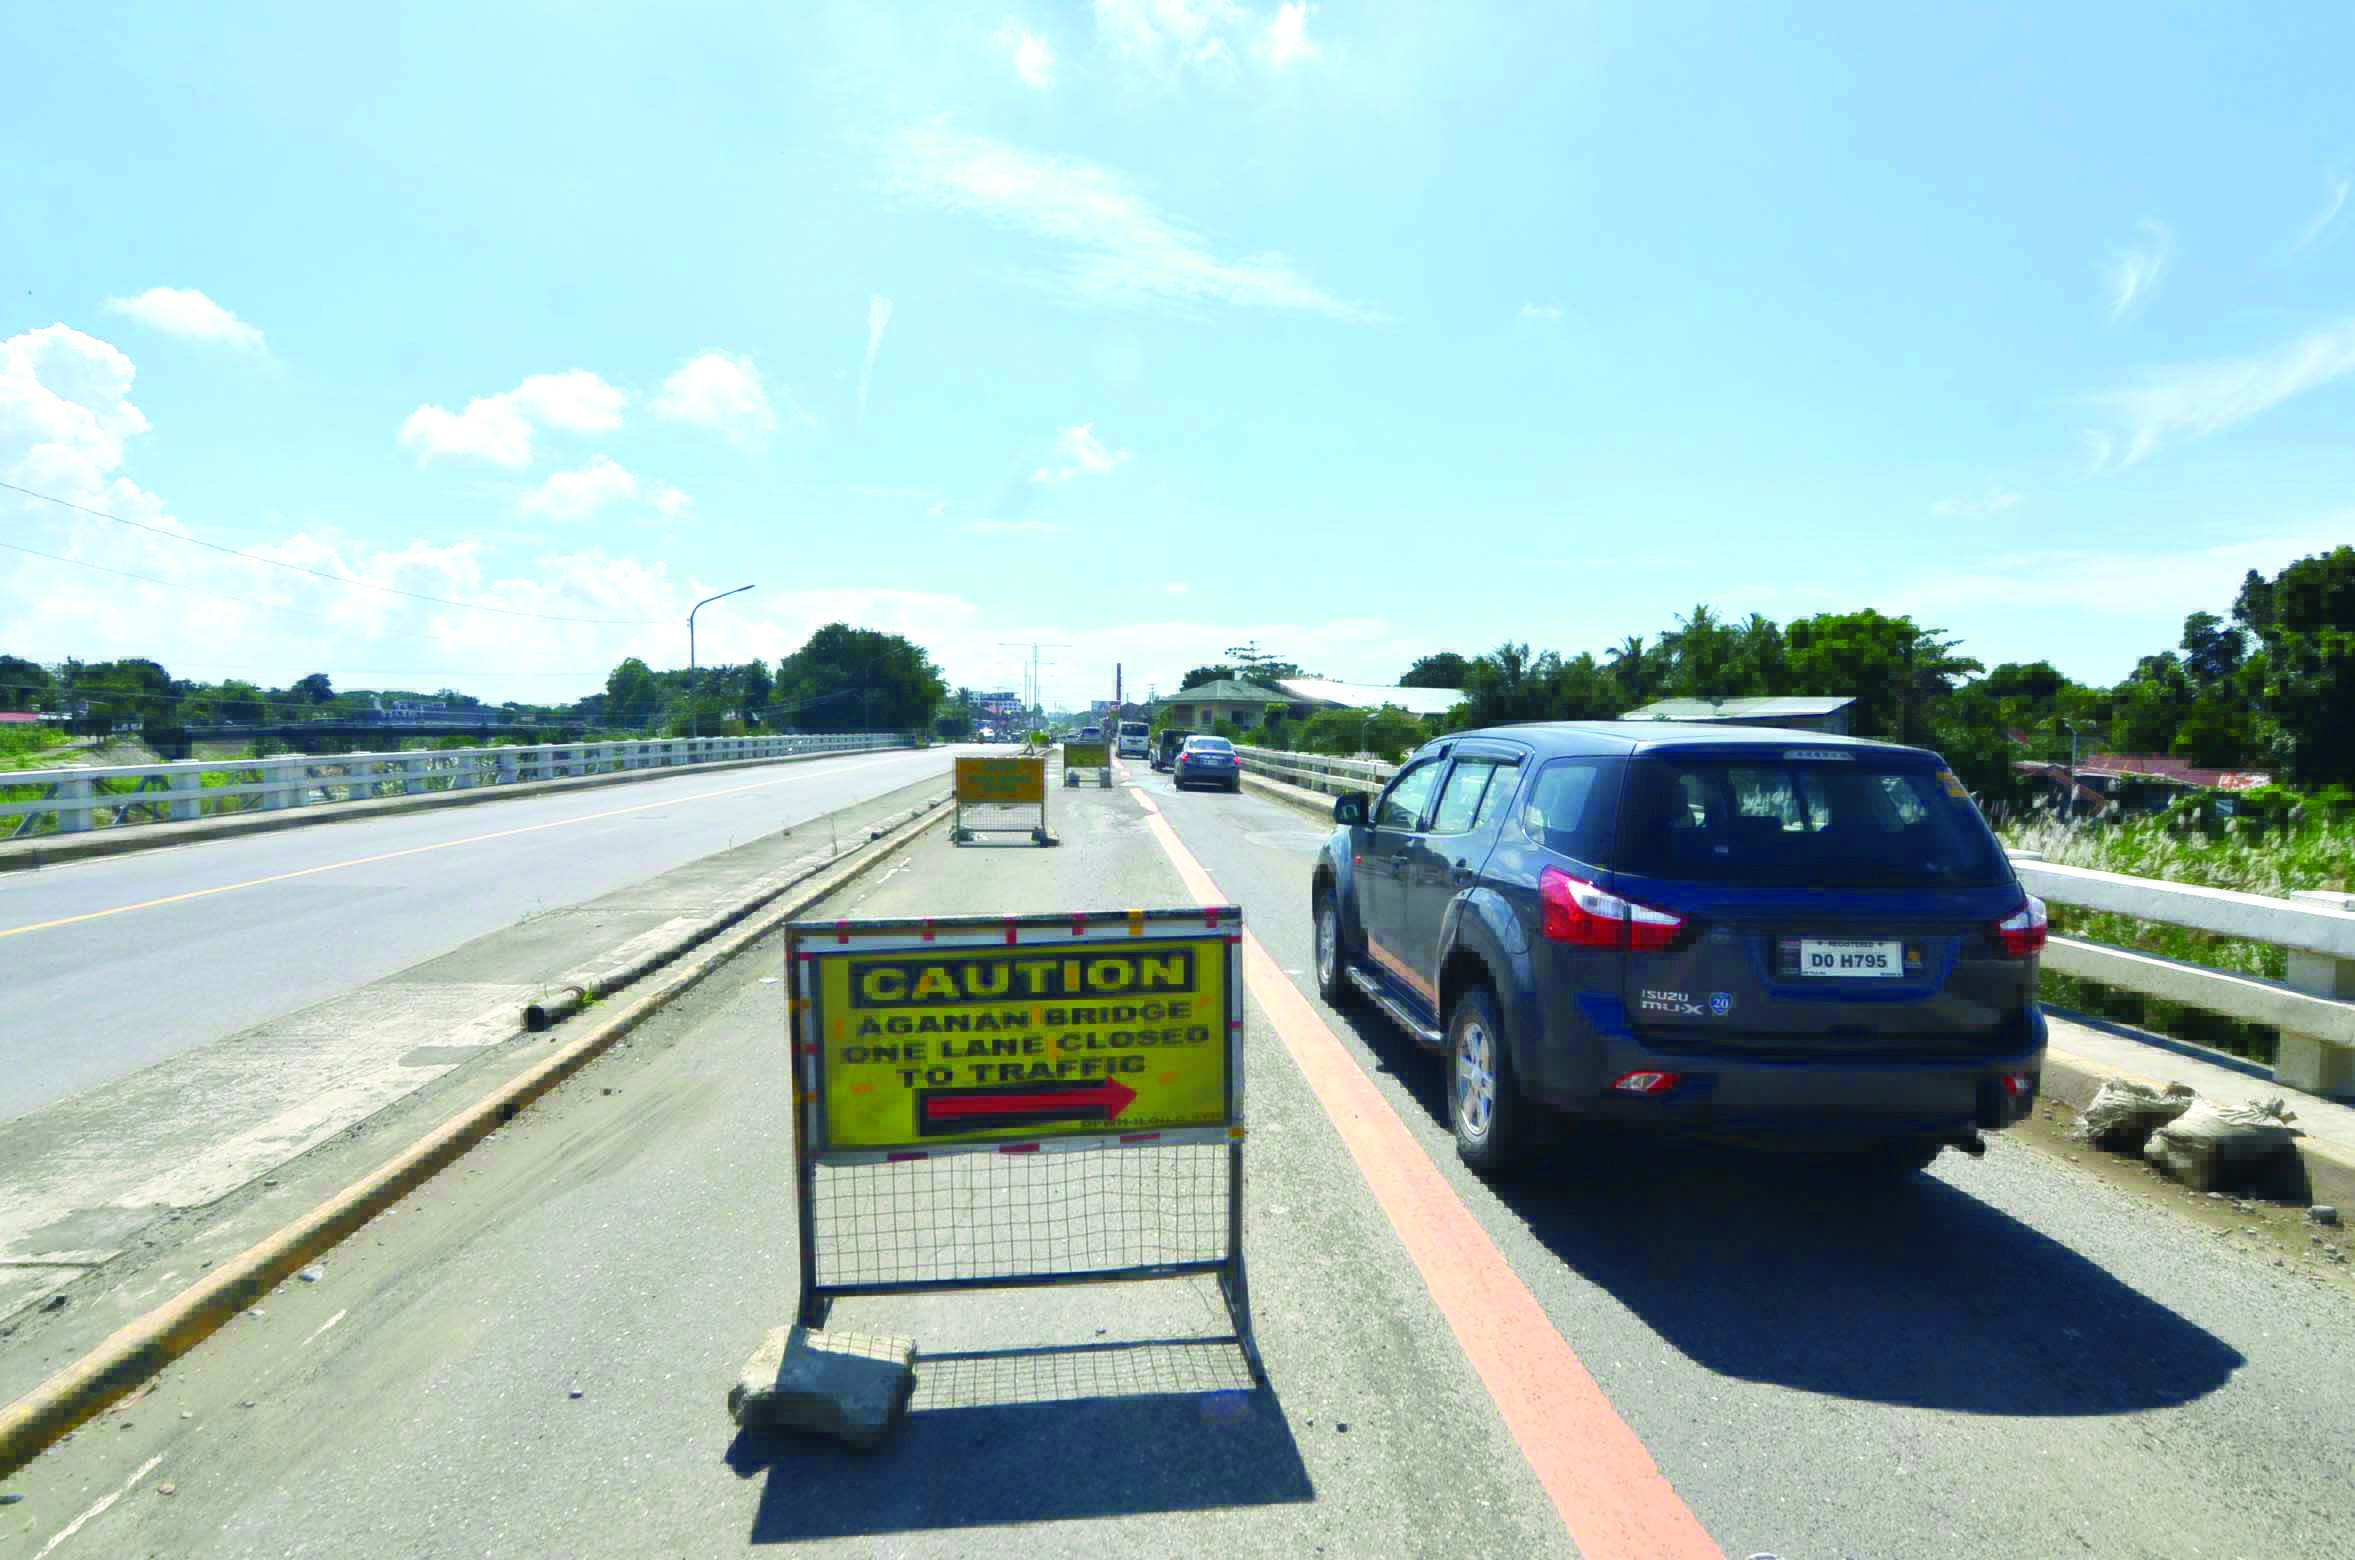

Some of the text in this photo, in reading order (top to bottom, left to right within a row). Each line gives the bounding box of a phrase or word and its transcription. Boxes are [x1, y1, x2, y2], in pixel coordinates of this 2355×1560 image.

[1840, 954, 1887, 968] H795
[862, 957, 1185, 1001] CAUTION
[1641, 988, 1689, 1002] ISUZU
[857, 1002, 1193, 1036] AGANAN BRIDGE
[844, 1025, 1209, 1065] ONE LANE CLOSED
[897, 1056, 1145, 1089] TO TRAFFIC
